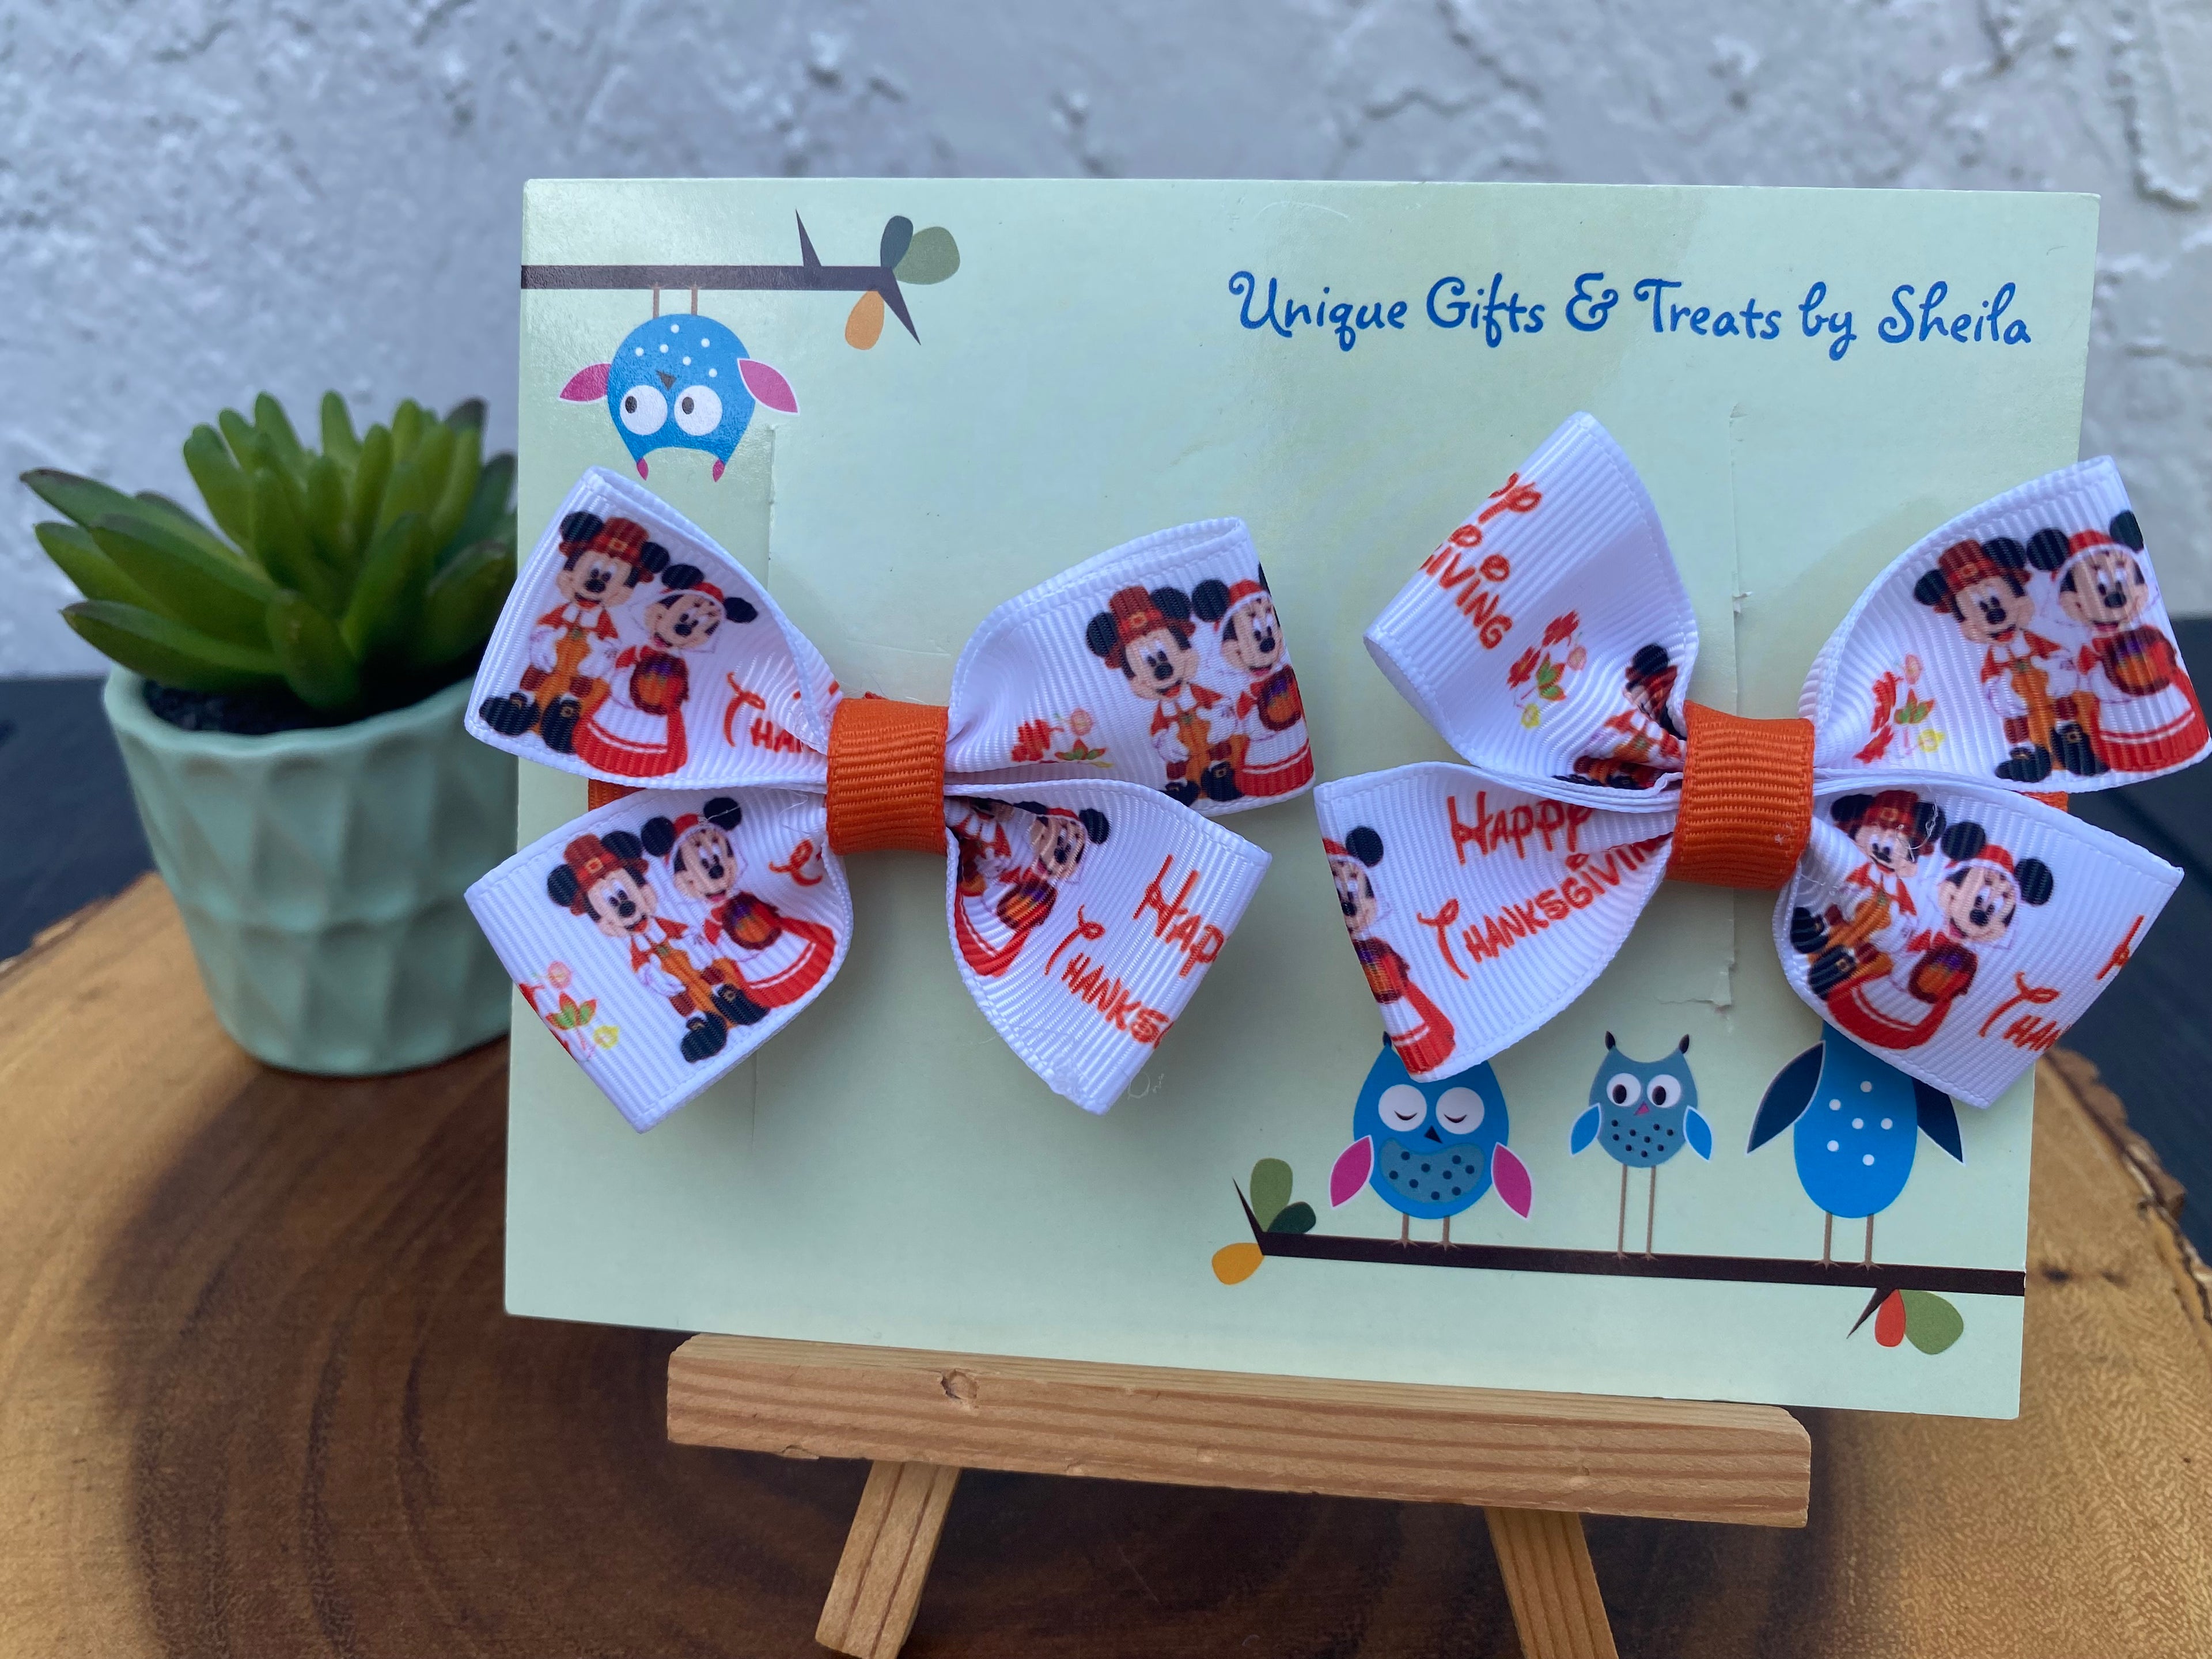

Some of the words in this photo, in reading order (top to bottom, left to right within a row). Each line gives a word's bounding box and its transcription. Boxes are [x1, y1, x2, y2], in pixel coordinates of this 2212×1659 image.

[1228, 270, 1408, 353] Unique
[1426, 272, 1547, 349] Gifts
[1565, 271, 1620, 332] &
[1633, 278, 1783, 340] Treats
[1798, 281, 1858, 362] by
[1877, 281, 2032, 346] Sheila
[1044, 904, 1174, 1050] THANKS
